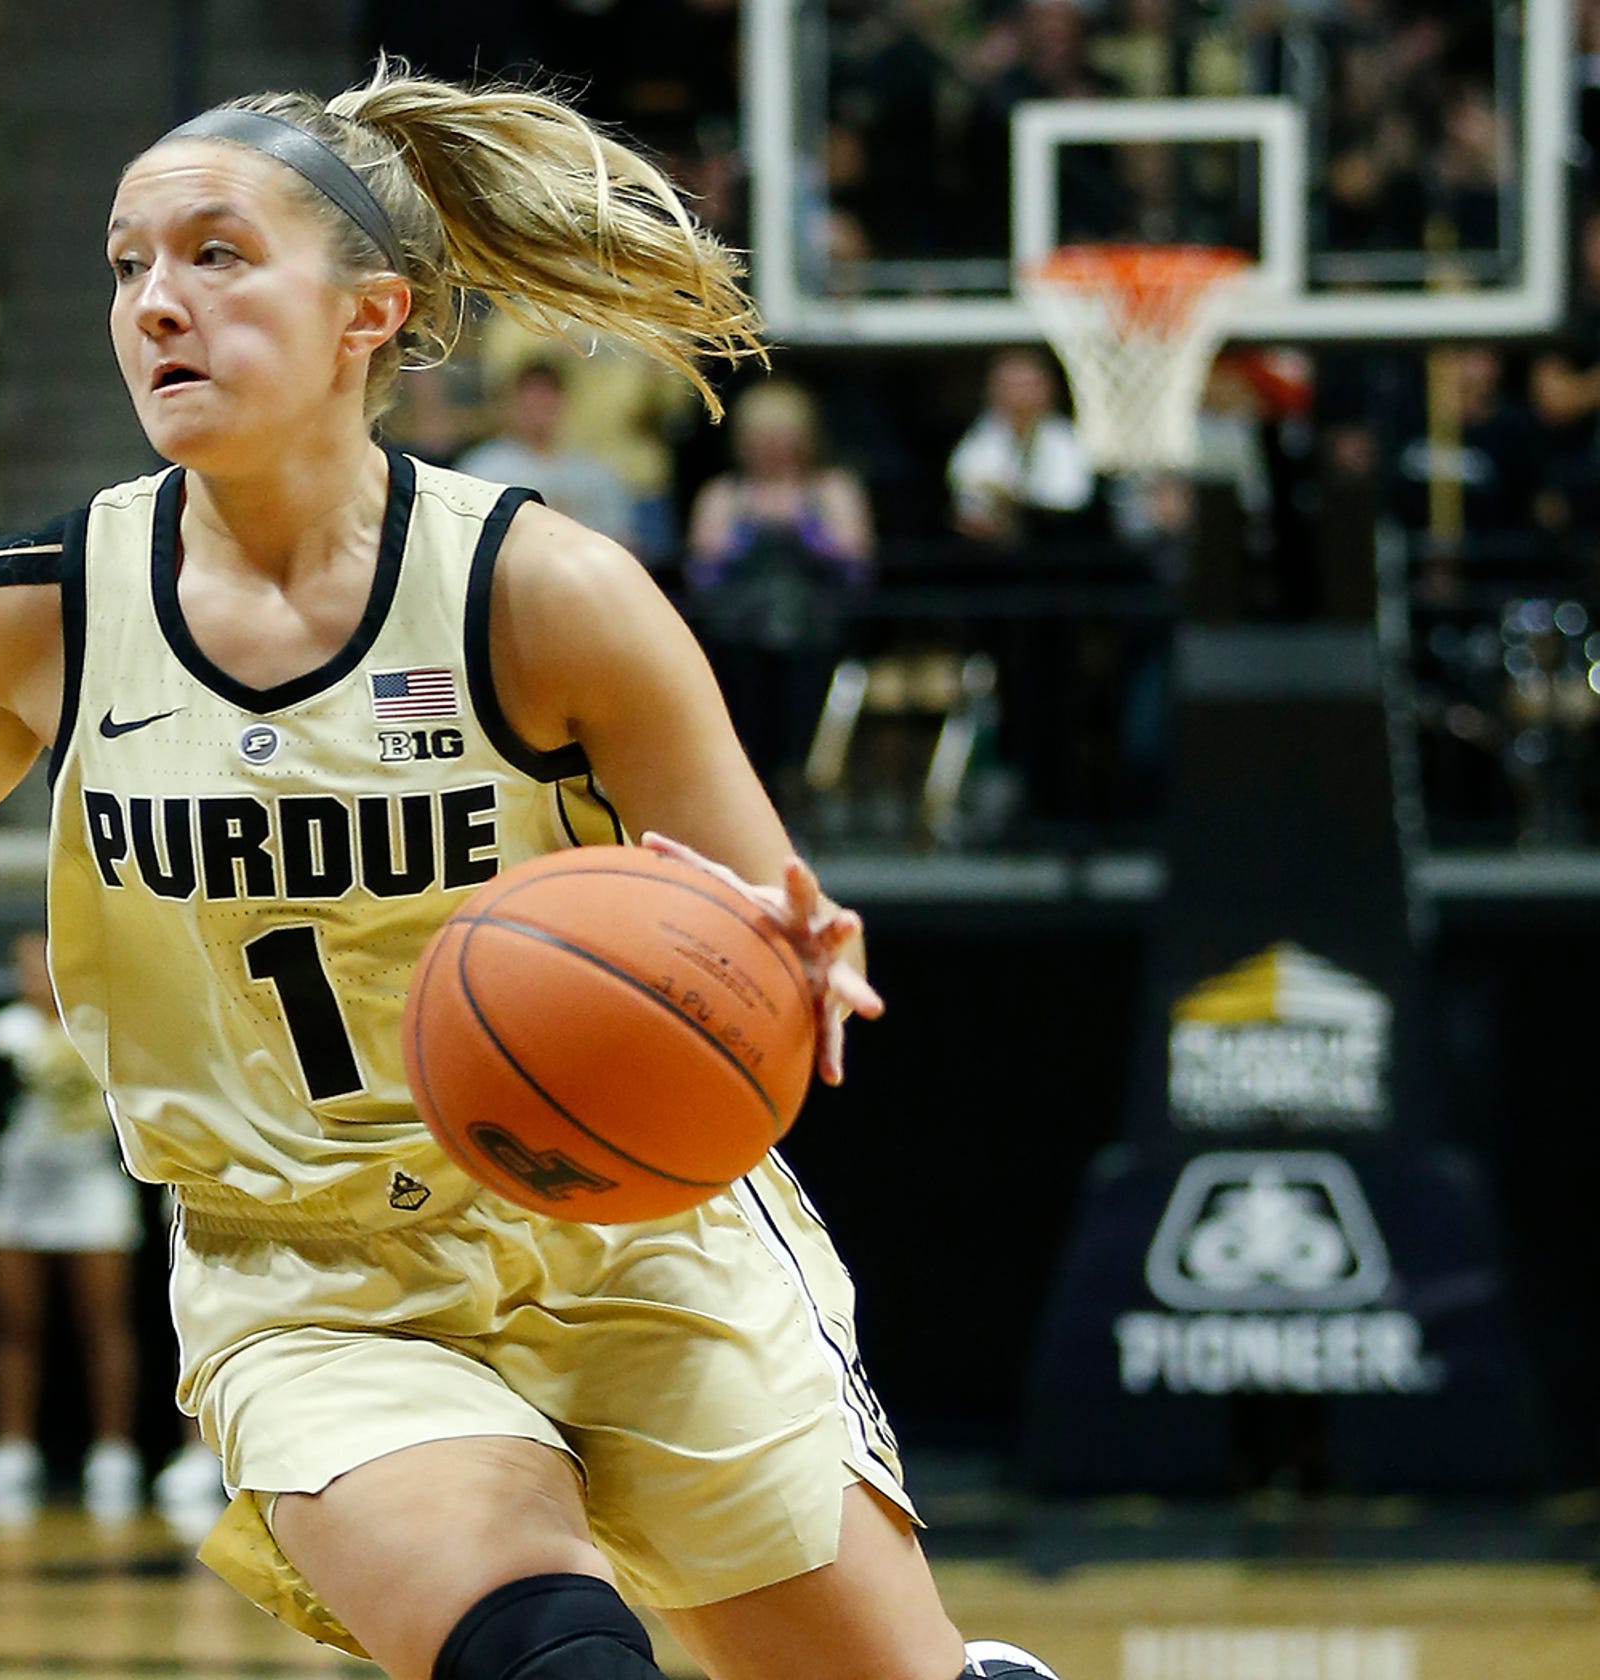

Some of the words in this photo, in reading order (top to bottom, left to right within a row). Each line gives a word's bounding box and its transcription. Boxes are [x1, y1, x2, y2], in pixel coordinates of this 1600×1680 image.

[82, 781, 501, 901] PURDUE
[241, 921, 370, 1107] 1
[1114, 1311, 1424, 1393] PIONEER
